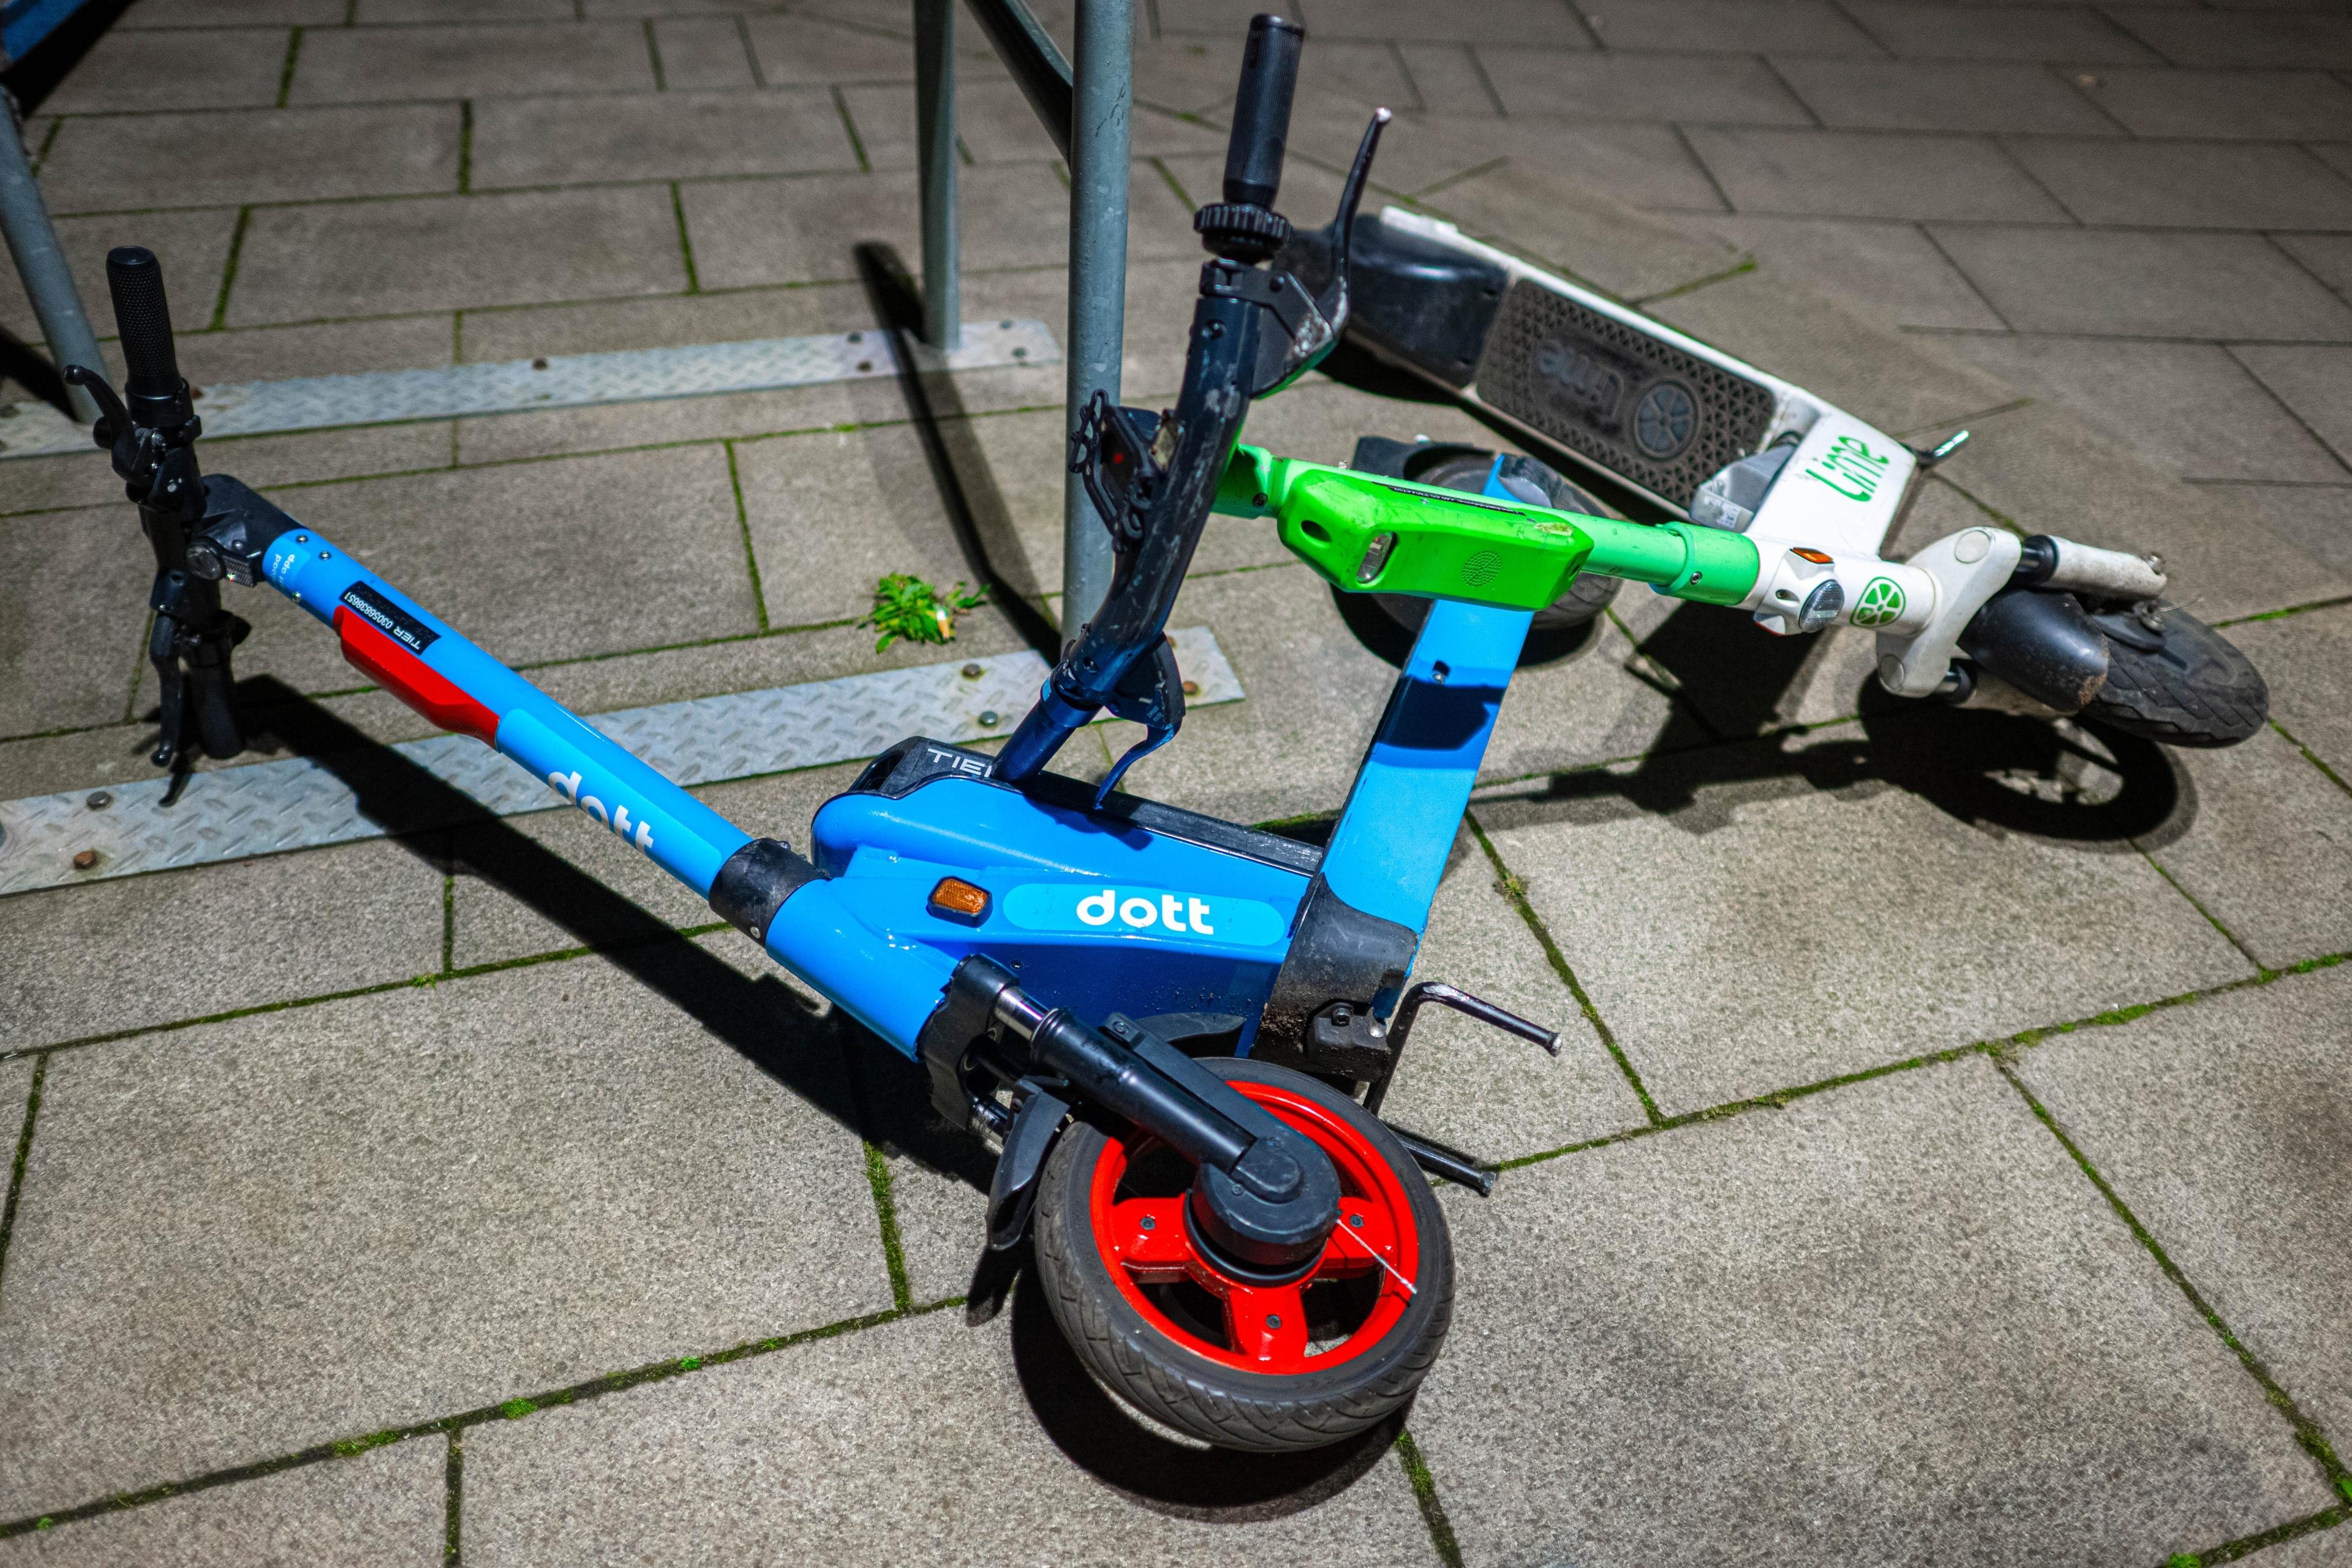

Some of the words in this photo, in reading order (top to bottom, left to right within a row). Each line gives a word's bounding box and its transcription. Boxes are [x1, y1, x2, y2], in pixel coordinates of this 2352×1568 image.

[1805, 435, 1890, 502] Lime
[344, 592, 394, 629] 03056838651
[393, 625, 422, 650] TIER
[548, 771, 654, 857] dott
[1076, 889, 1214, 935] dott
